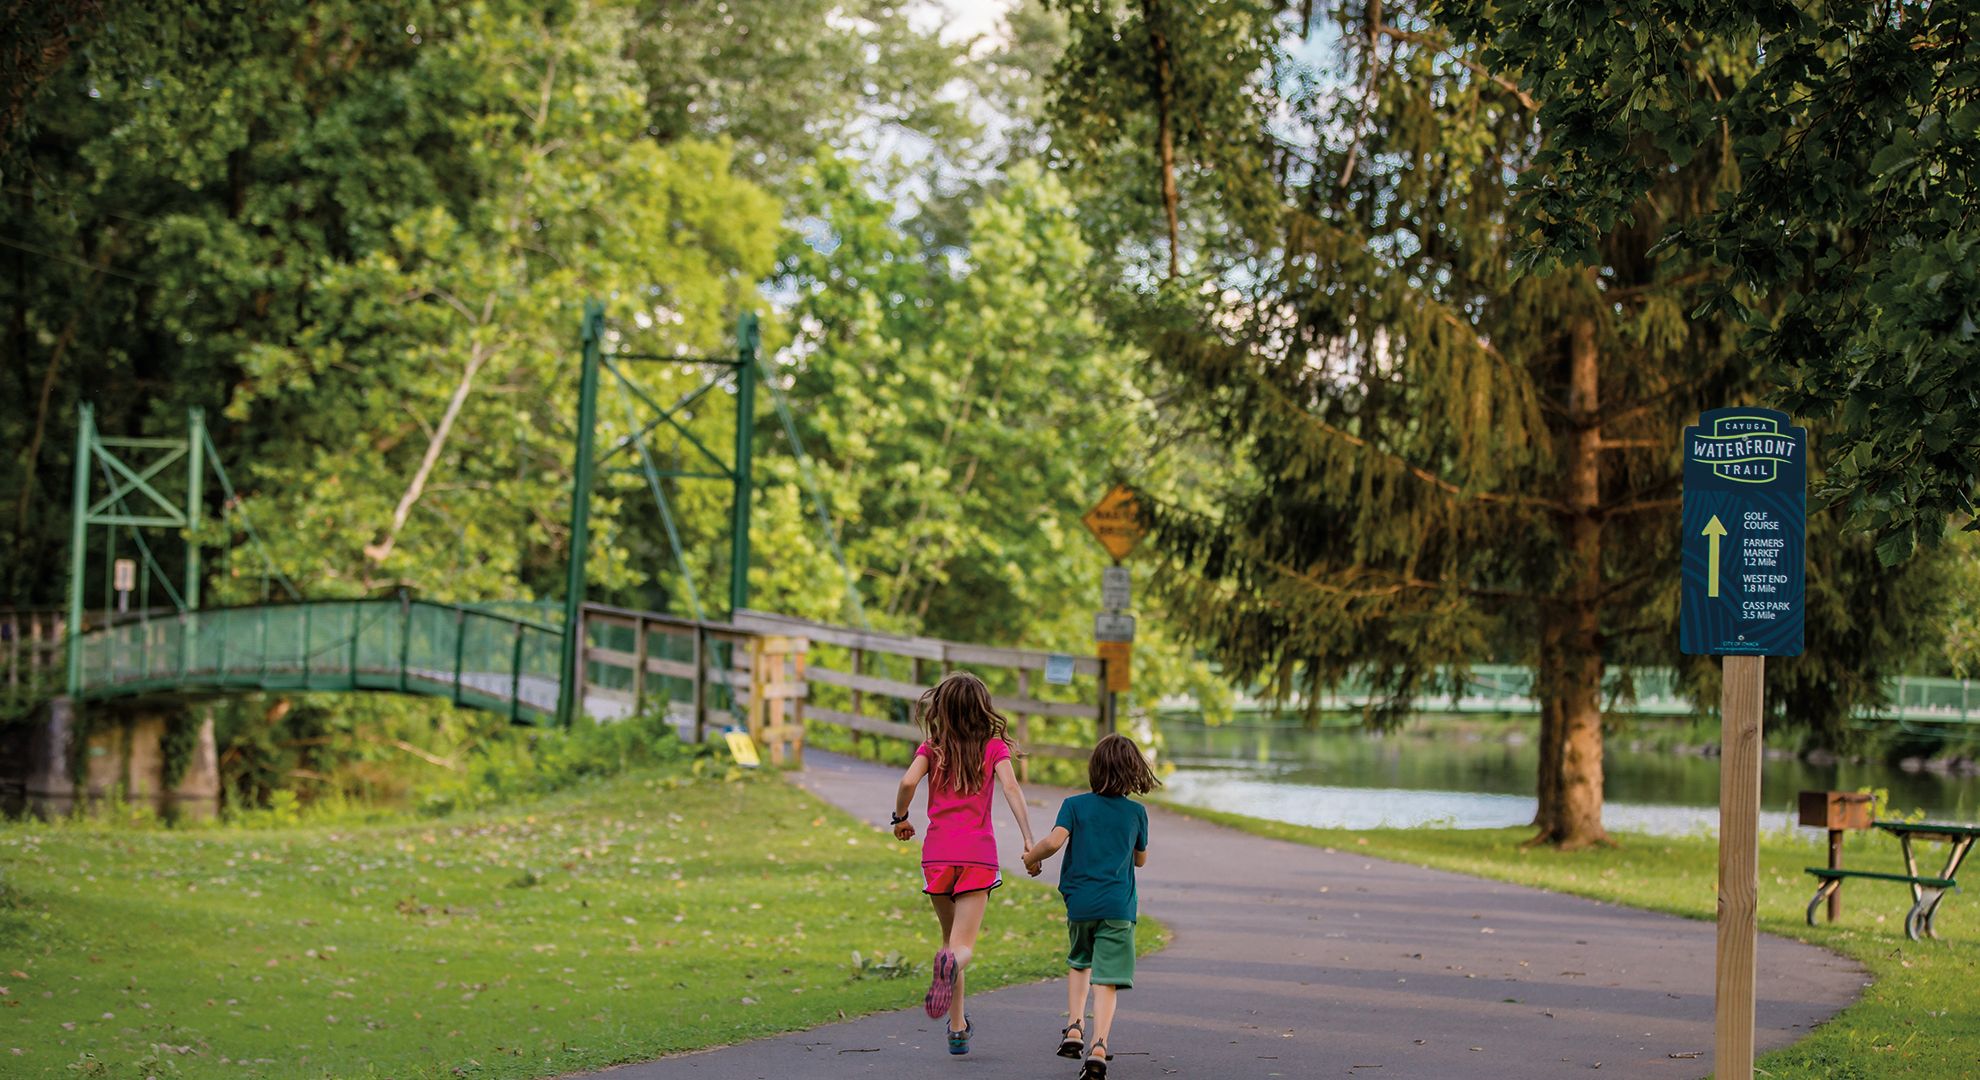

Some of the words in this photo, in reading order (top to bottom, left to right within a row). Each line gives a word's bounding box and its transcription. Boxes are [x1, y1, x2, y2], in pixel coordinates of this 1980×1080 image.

[1694, 440, 1795, 457] WATERFRONT
[1723, 464, 1768, 475] TRAIL
[1744, 512, 1768, 520] GOLF
[1744, 521, 1779, 530] COURSE
[1744, 539, 1784, 547] FARMERS
[1744, 549, 1779, 557] MARKET
[1744, 558, 1757, 566] 1.2
[1758, 558, 1776, 566] Mile
[1742, 574, 1767, 583] WEST
[1768, 574, 1788, 583] END
[1743, 584, 1756, 593] 1.8
[1757, 584, 1776, 593] Mile
[1742, 601, 1765, 610] CASS
[1766, 602, 1790, 611] PARK
[1742, 611, 1755, 619] 3.5
[1757, 611, 1775, 619] Mile
